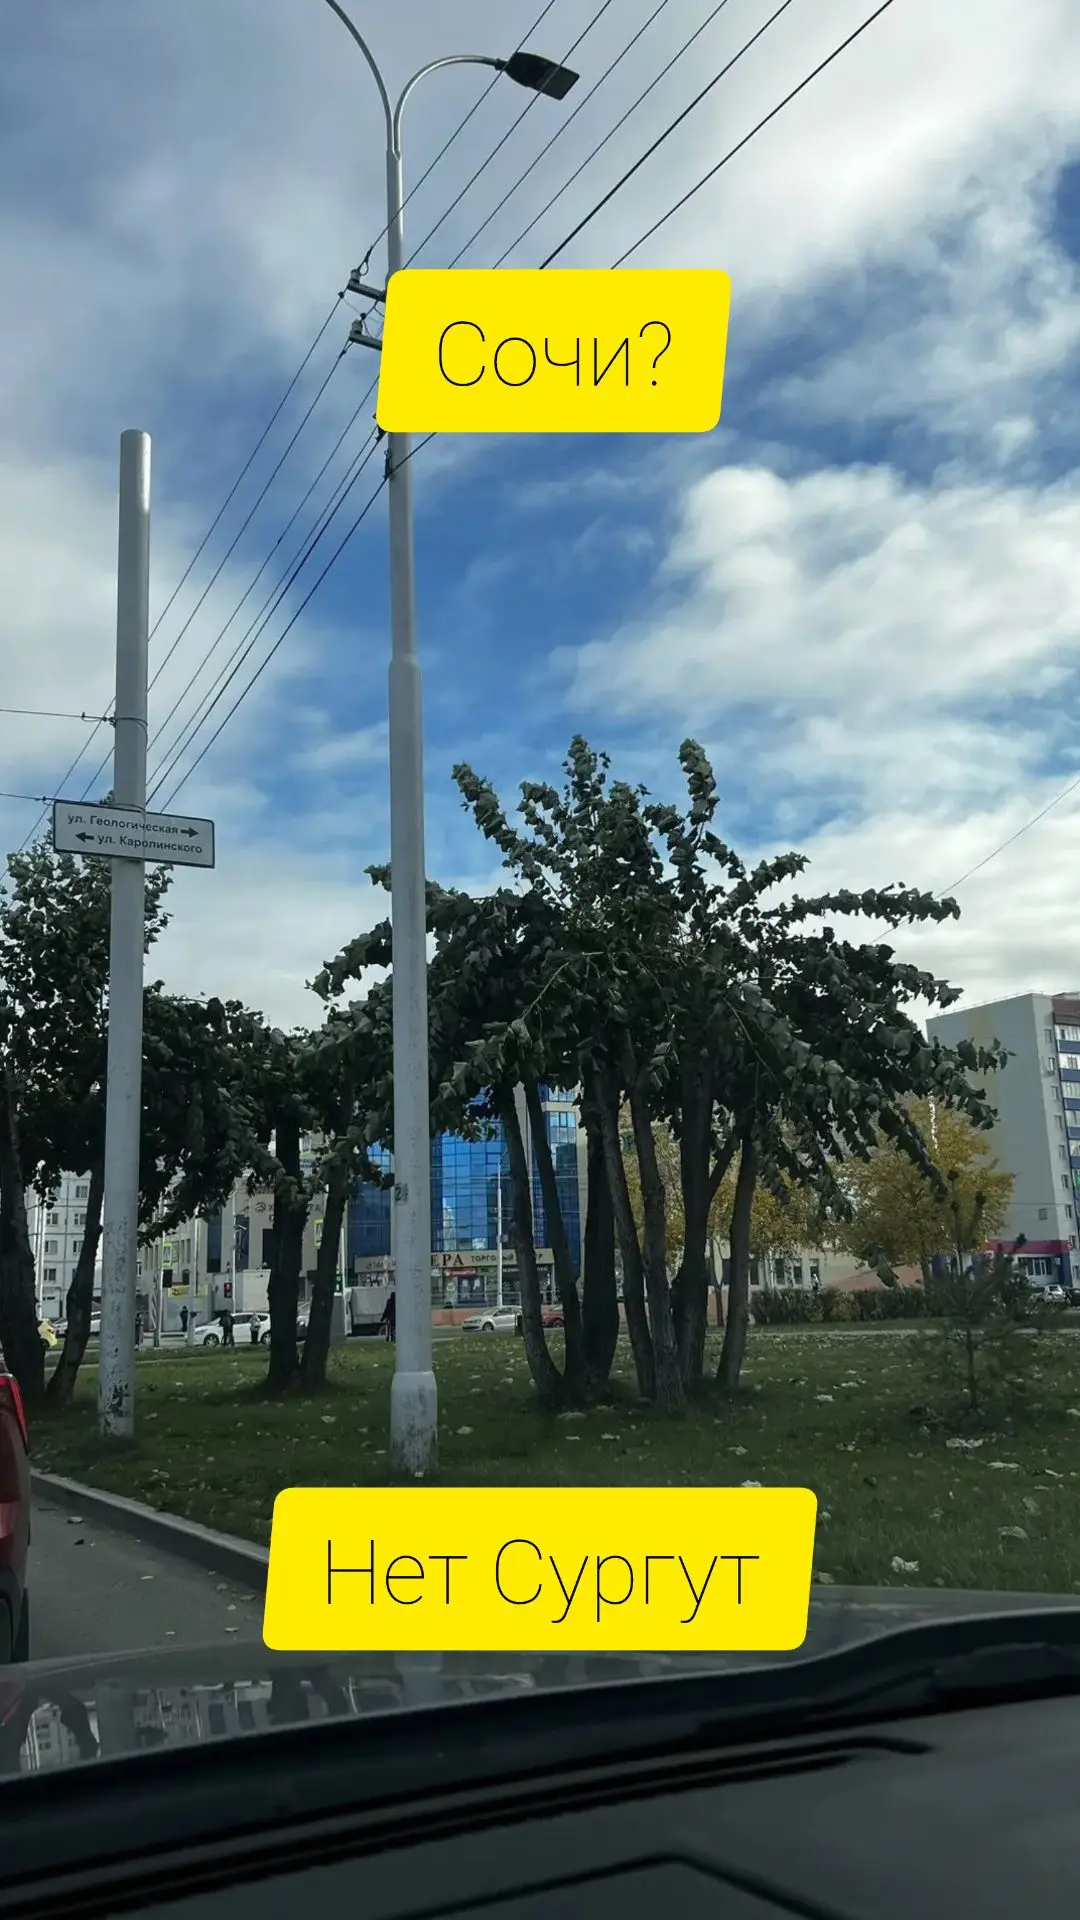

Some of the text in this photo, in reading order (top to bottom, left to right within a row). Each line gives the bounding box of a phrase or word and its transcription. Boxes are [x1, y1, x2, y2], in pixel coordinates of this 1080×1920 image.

[67, 814, 179, 835] ул. Геологическая
[97, 834, 203, 854] ул. Каролинского
[470, 1253, 514, 1263] ТОРГОЫЙ
